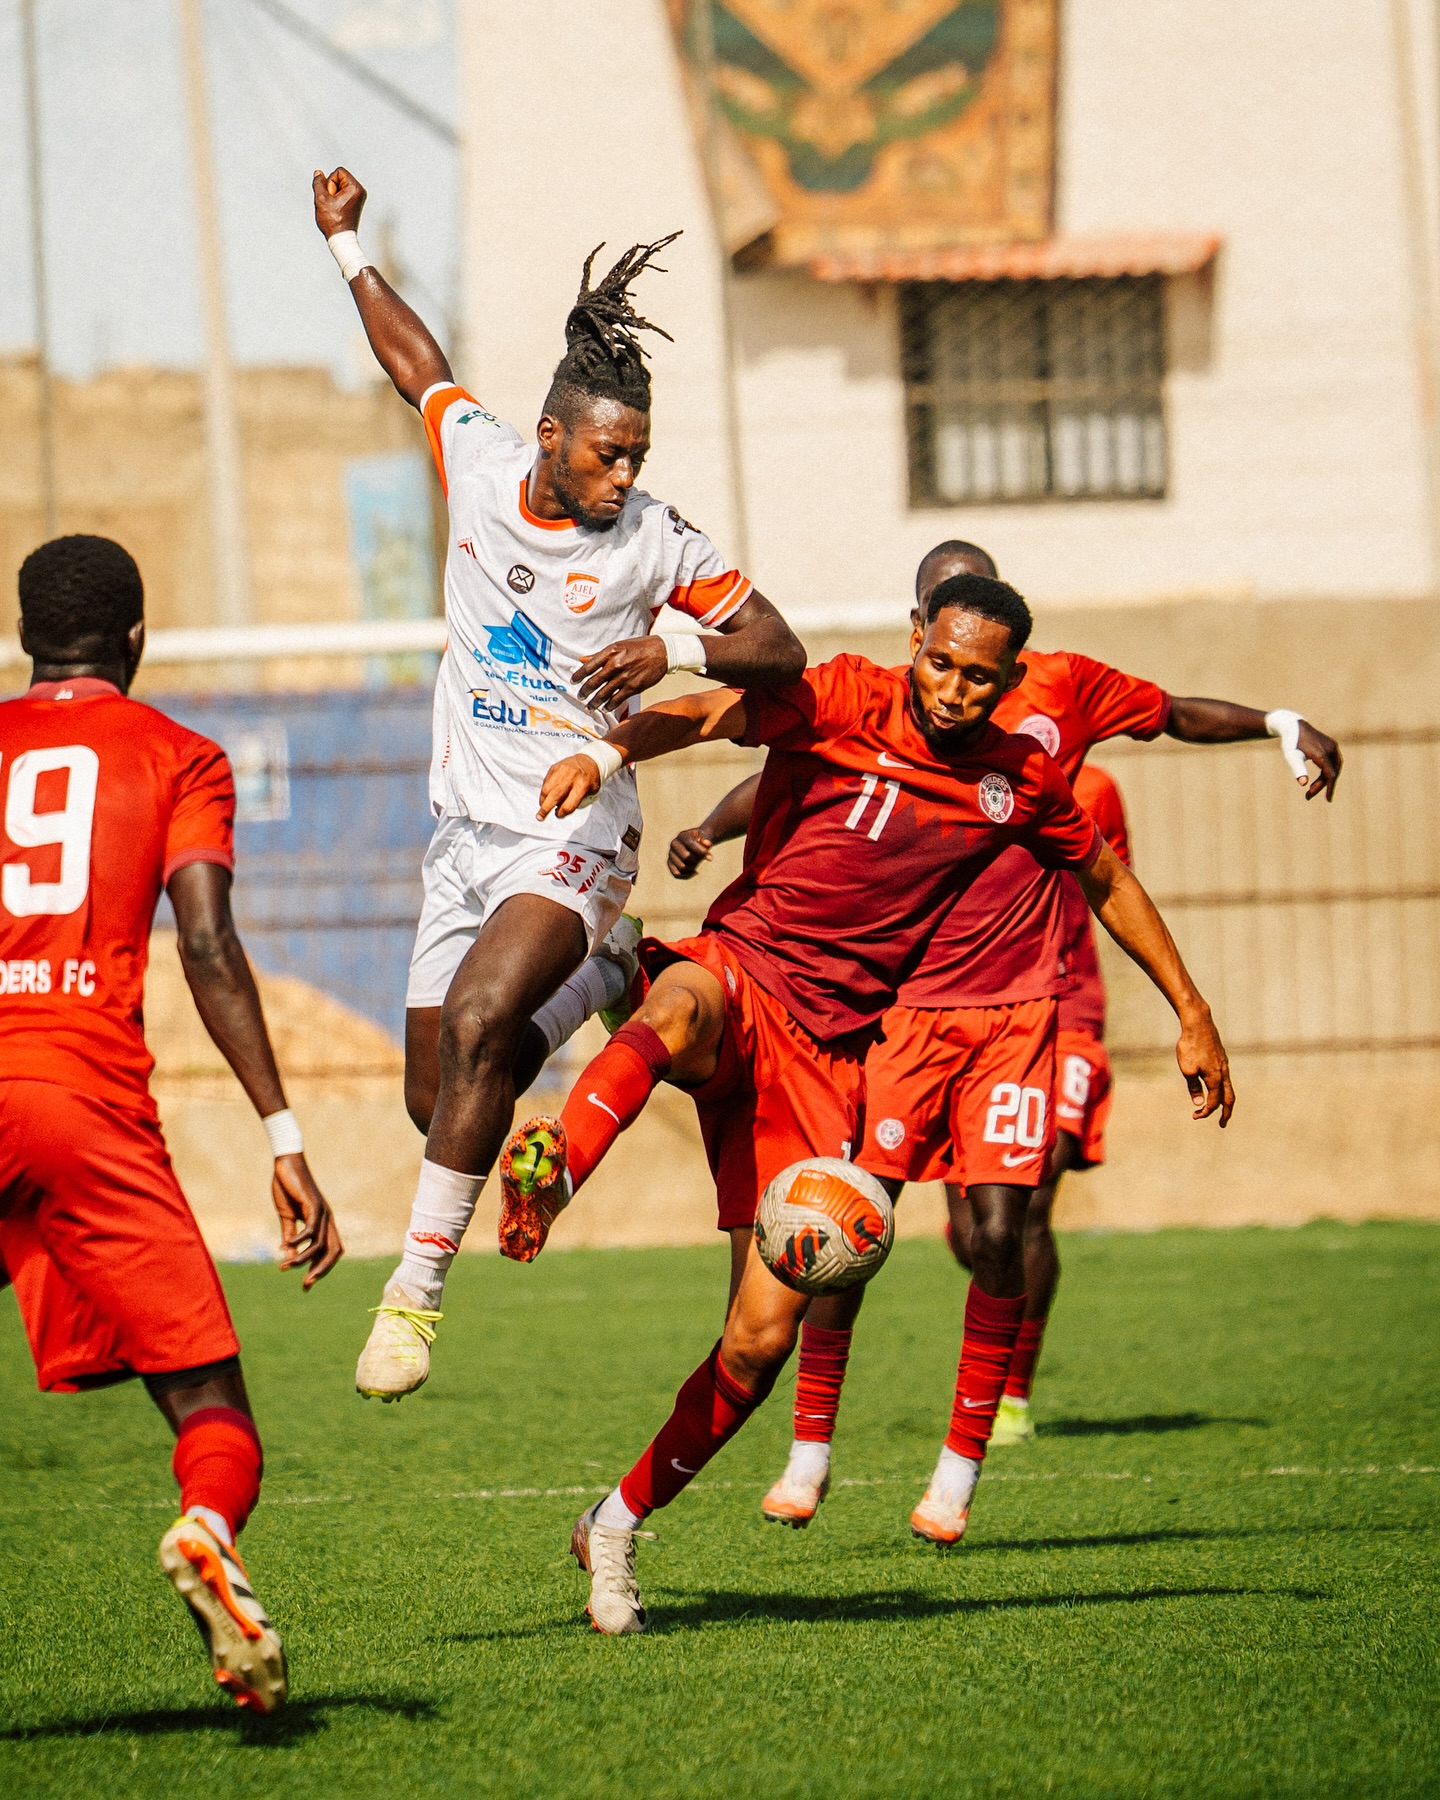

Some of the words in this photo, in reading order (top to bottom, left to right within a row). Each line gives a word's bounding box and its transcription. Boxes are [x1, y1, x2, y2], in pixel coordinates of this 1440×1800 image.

[572, 583, 594, 596] AJEL
[0, 744, 99, 918] 9
[844, 772, 901, 842] 11
[556, 851, 587, 874] 25
[62, 957, 97, 998] FC
[983, 1082, 1046, 1148] 20
